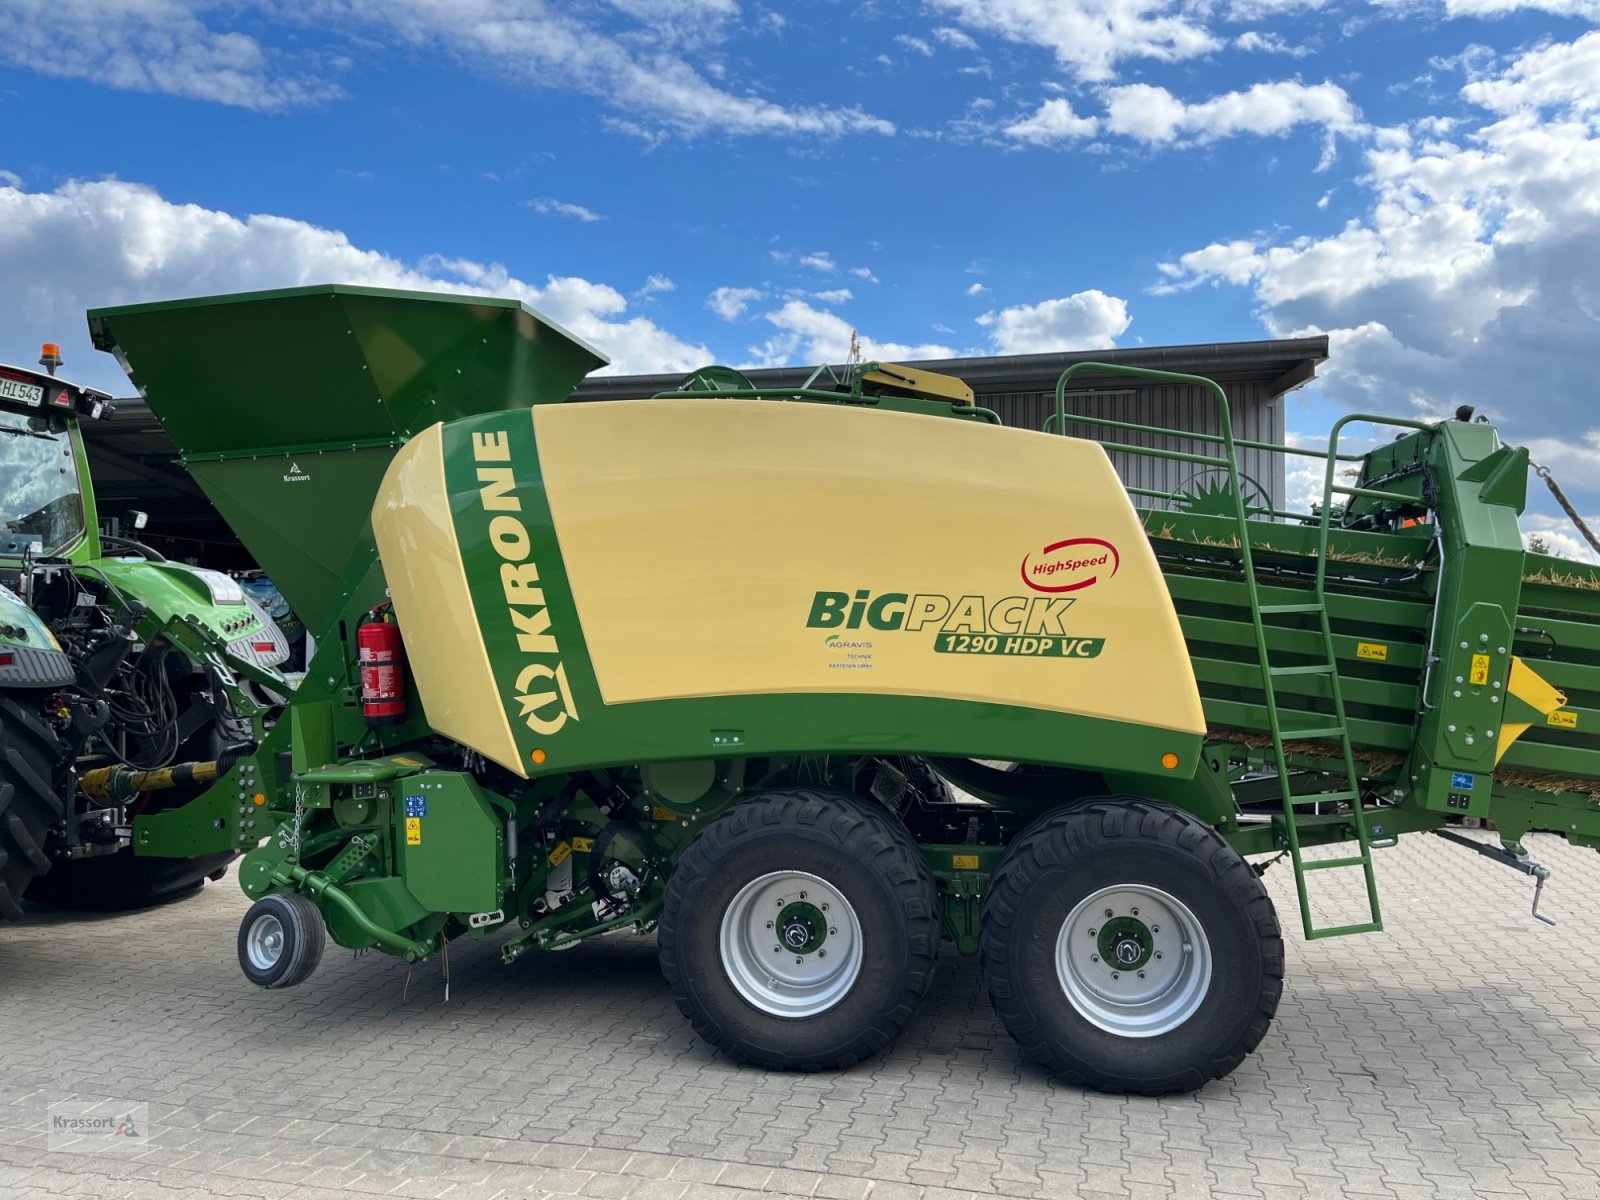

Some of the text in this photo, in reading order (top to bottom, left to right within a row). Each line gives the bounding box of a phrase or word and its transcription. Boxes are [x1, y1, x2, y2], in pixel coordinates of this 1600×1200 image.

[18, 384, 40, 402] 543
[283, 474, 311, 482] Krassort
[471, 430, 559, 653] KRONE
[1032, 553, 1108, 576] HighSpeed
[829, 641, 873, 649] AGRAVIS
[945, 635, 1093, 657] 1290 HDP VC
